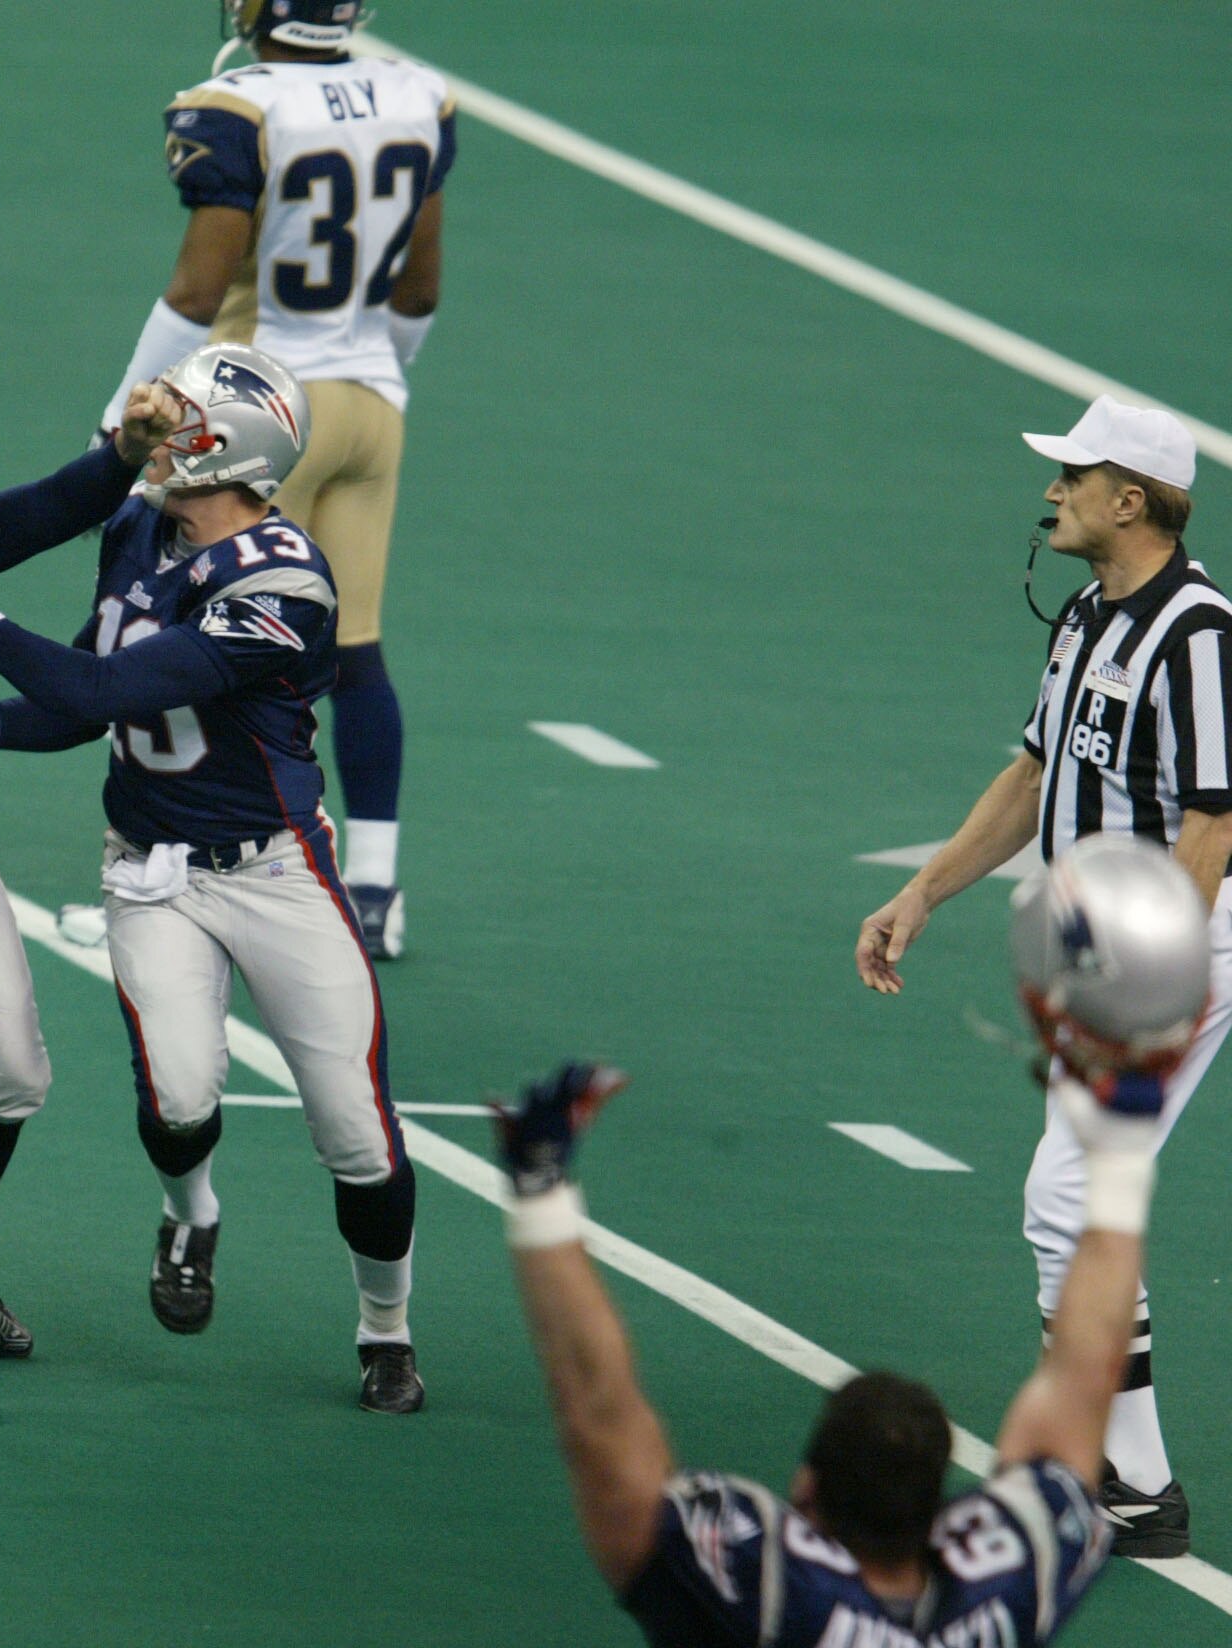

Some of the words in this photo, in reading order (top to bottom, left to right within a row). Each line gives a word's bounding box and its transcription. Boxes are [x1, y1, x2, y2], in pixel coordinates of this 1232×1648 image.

[320, 79, 379, 121] BLY
[273, 141, 431, 312] 32
[233, 526, 311, 568] 13
[1087, 693, 1106, 727] R
[1071, 723, 1112, 766] 86
